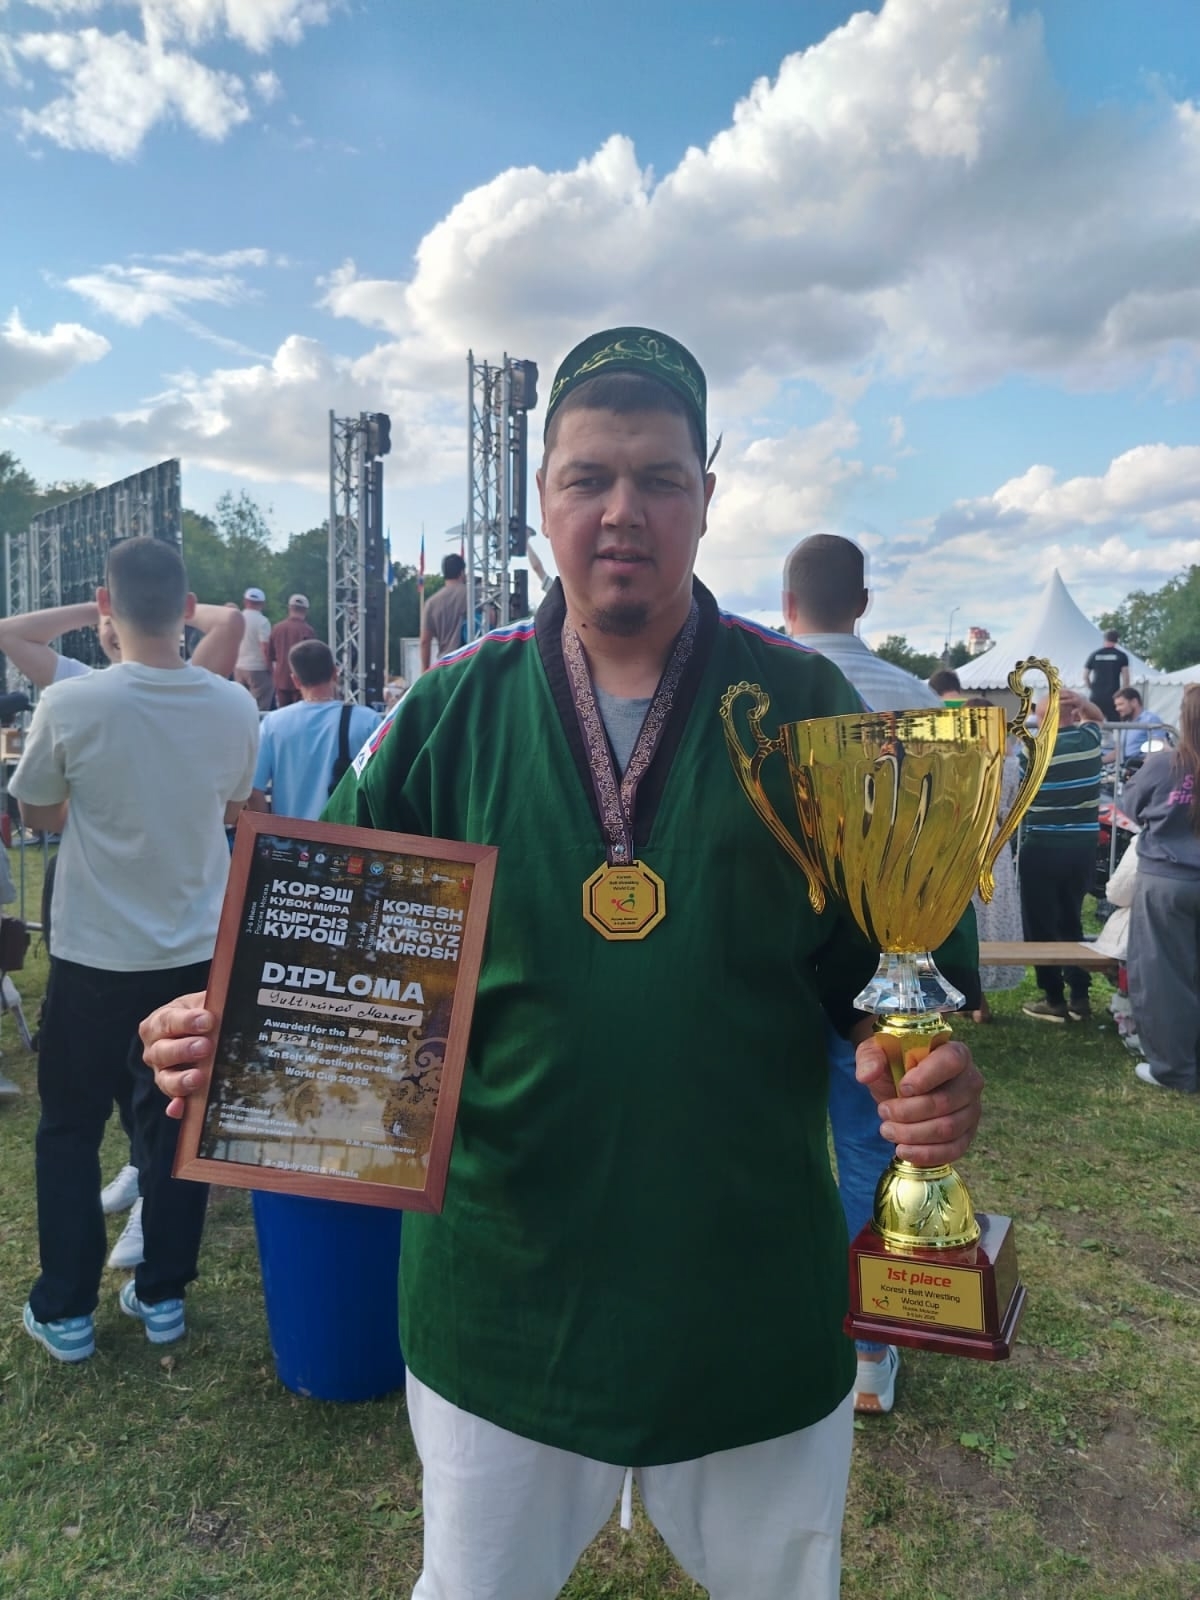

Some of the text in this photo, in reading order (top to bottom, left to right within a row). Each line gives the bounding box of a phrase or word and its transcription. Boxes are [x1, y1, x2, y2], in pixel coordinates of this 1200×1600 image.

[272, 880, 354, 904] КОРЭШ
[270, 896, 350, 915] КУБОК МИРА
[382, 900, 464, 921] KORESH
[266, 908, 348, 930] КЫРГЫЗ
[382, 914, 462, 933] WORLD CUP
[264, 921, 346, 946] КУРОШ
[378, 925, 460, 948] KYRGYZ
[376, 939, 458, 962] KUROSH
[261, 962, 424, 1004] DIPLOMA
[264, 1018, 311, 1032] Awarded
[311, 1024, 328, 1034] for
[328, 1028, 346, 1036] the
[379, 1035, 408, 1046] place
[258, 1032, 268, 1042] in
[310, 1040, 324, 1050] kg
[325, 1044, 360, 1054] weight
[360, 1048, 408, 1062] category
[268, 1050, 393, 1074] In Belt Wrestling Koresh
[285, 1066, 315, 1078] World
[316, 1072, 338, 1082] Cup
[888, 1268, 951, 1287] 1st place
[881, 1284, 960, 1303] Koresh Belt Wrestling
[901, 1297, 940, 1310] World Cup
